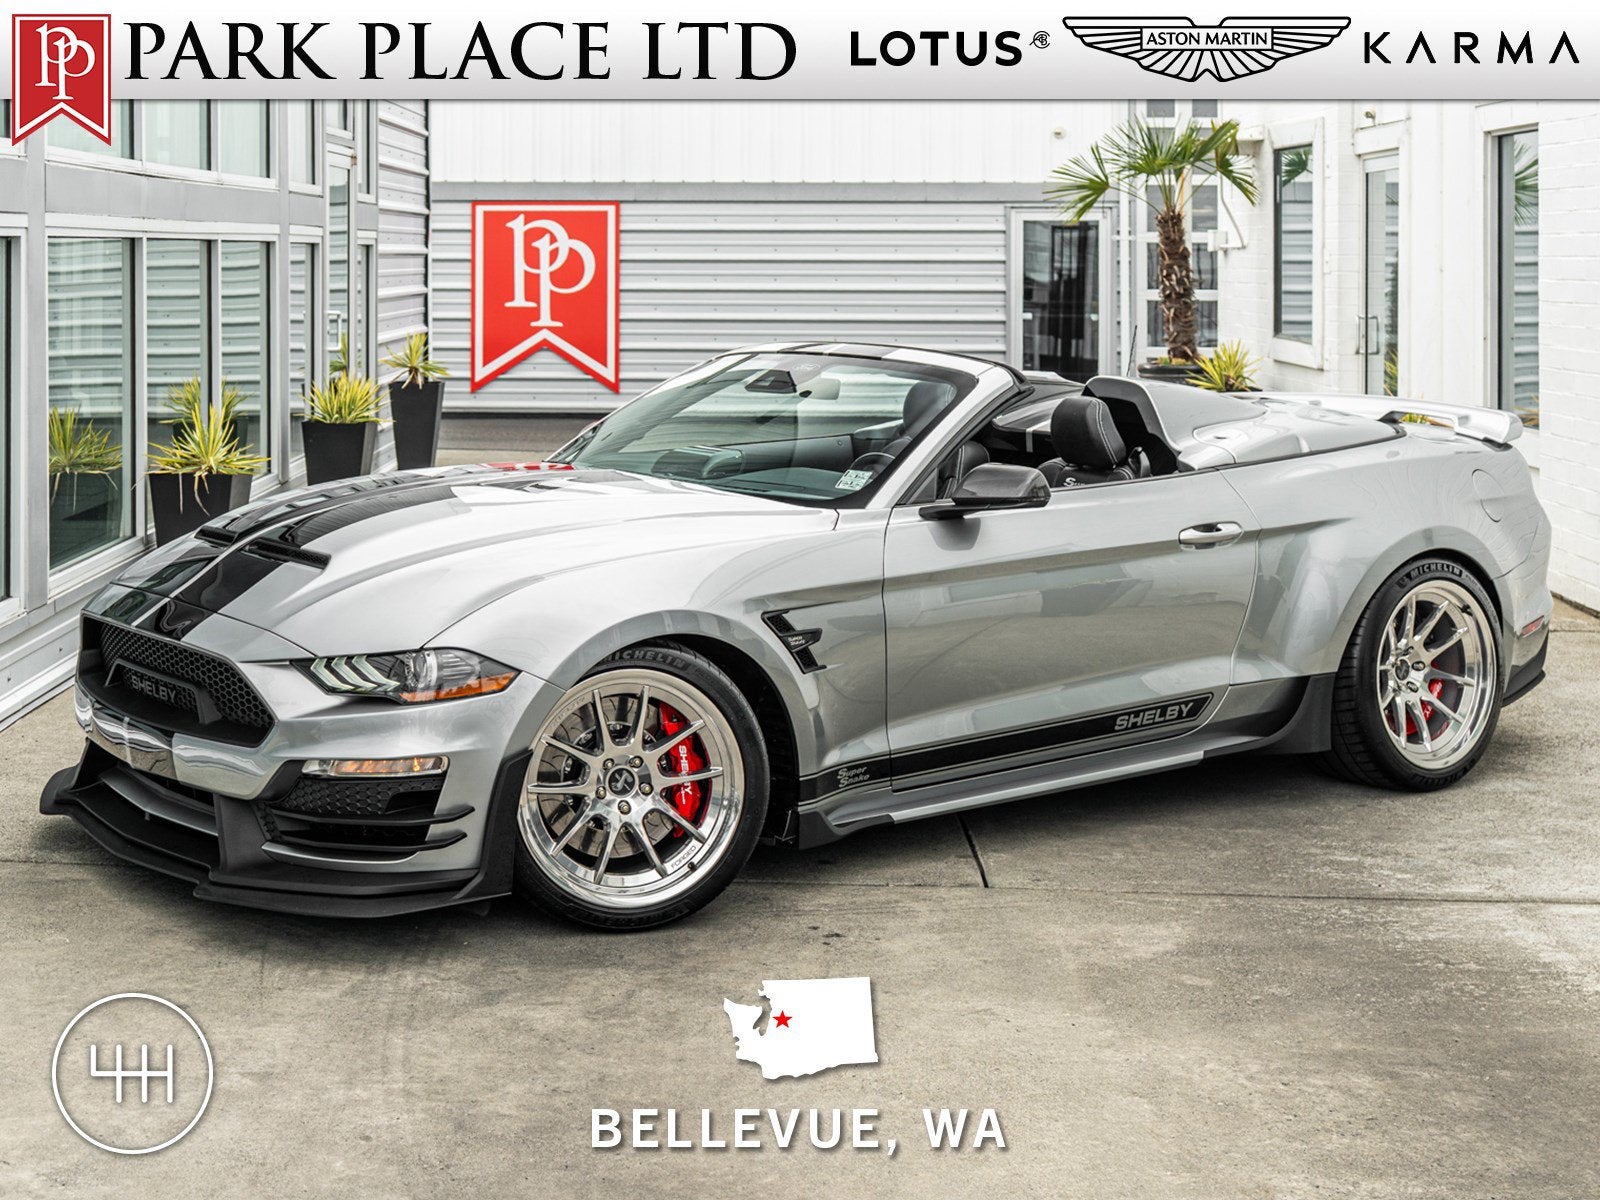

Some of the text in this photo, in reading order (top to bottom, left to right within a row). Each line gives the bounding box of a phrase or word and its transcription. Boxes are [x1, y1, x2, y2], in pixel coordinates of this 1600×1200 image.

[1411, 563, 1461, 577] MICHELIN
[131, 675, 178, 705] SHELBY
[1114, 702, 1194, 731] SHELBY
[837, 766, 868, 780] Super
[838, 774, 870, 788] Snake
